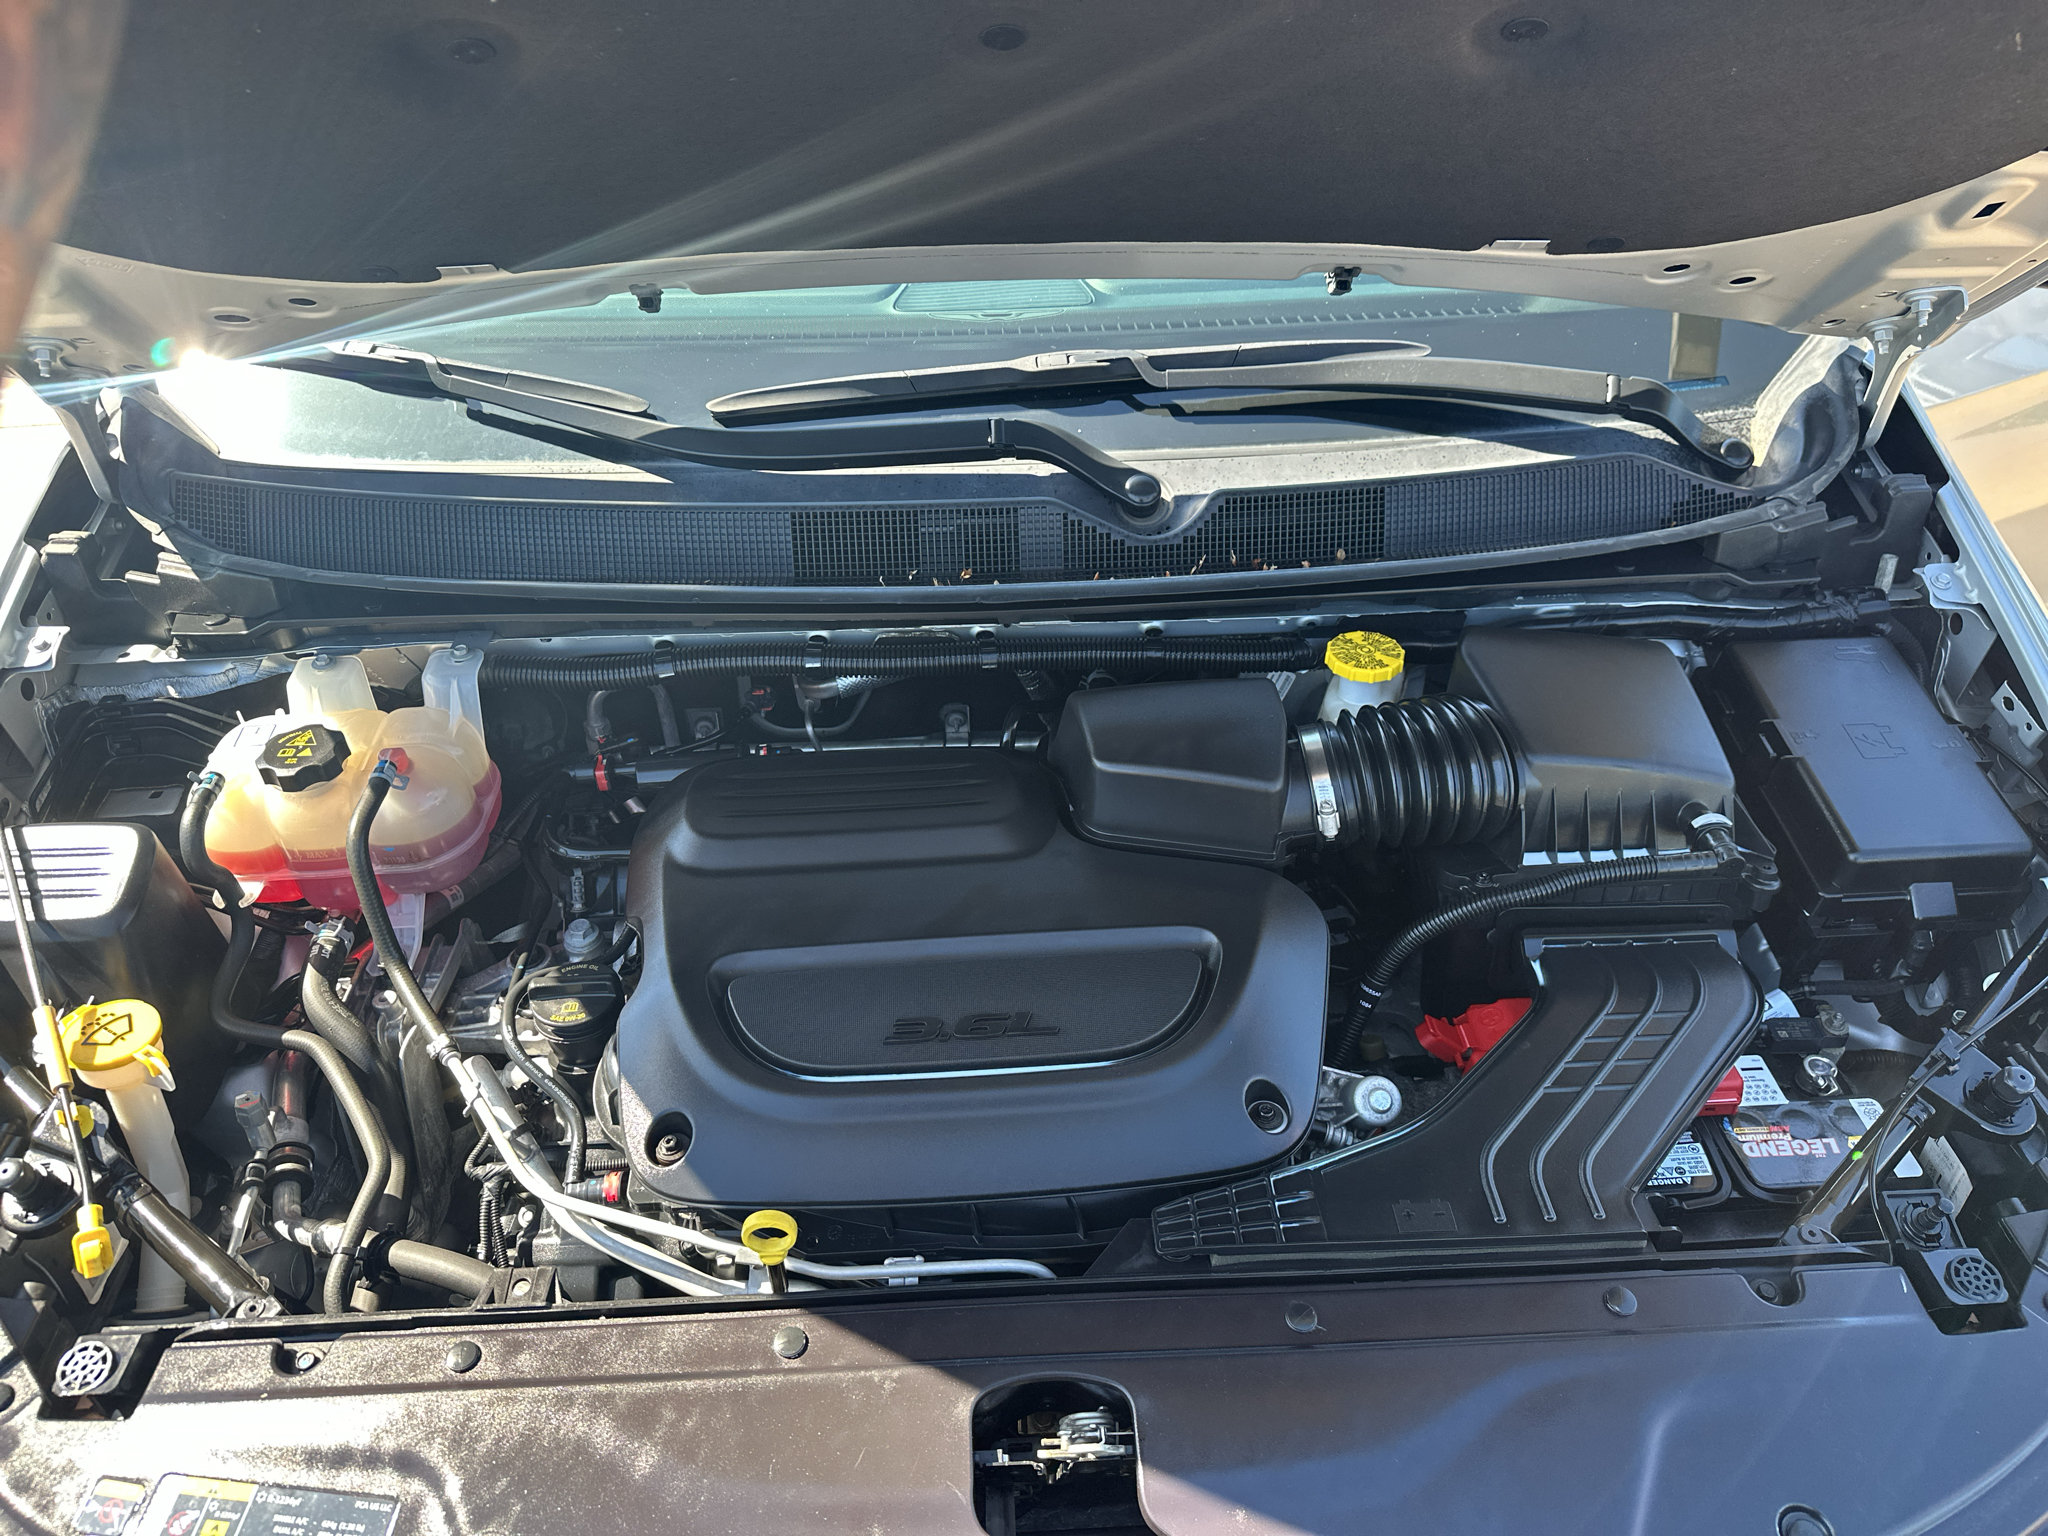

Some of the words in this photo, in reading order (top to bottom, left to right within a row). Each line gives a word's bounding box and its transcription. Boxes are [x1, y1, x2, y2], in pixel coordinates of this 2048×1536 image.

[561, 963, 588, 973] ENGINE
[550, 1014, 564, 1022] SAE
[564, 1012, 586, 1022] 0W-20
[882, 1010, 1061, 1046] 3.6L
[1738, 1133, 1793, 1142] Premium
[1742, 1138, 1841, 1158] LEGEND
[355, 1500, 369, 1509] FCA
